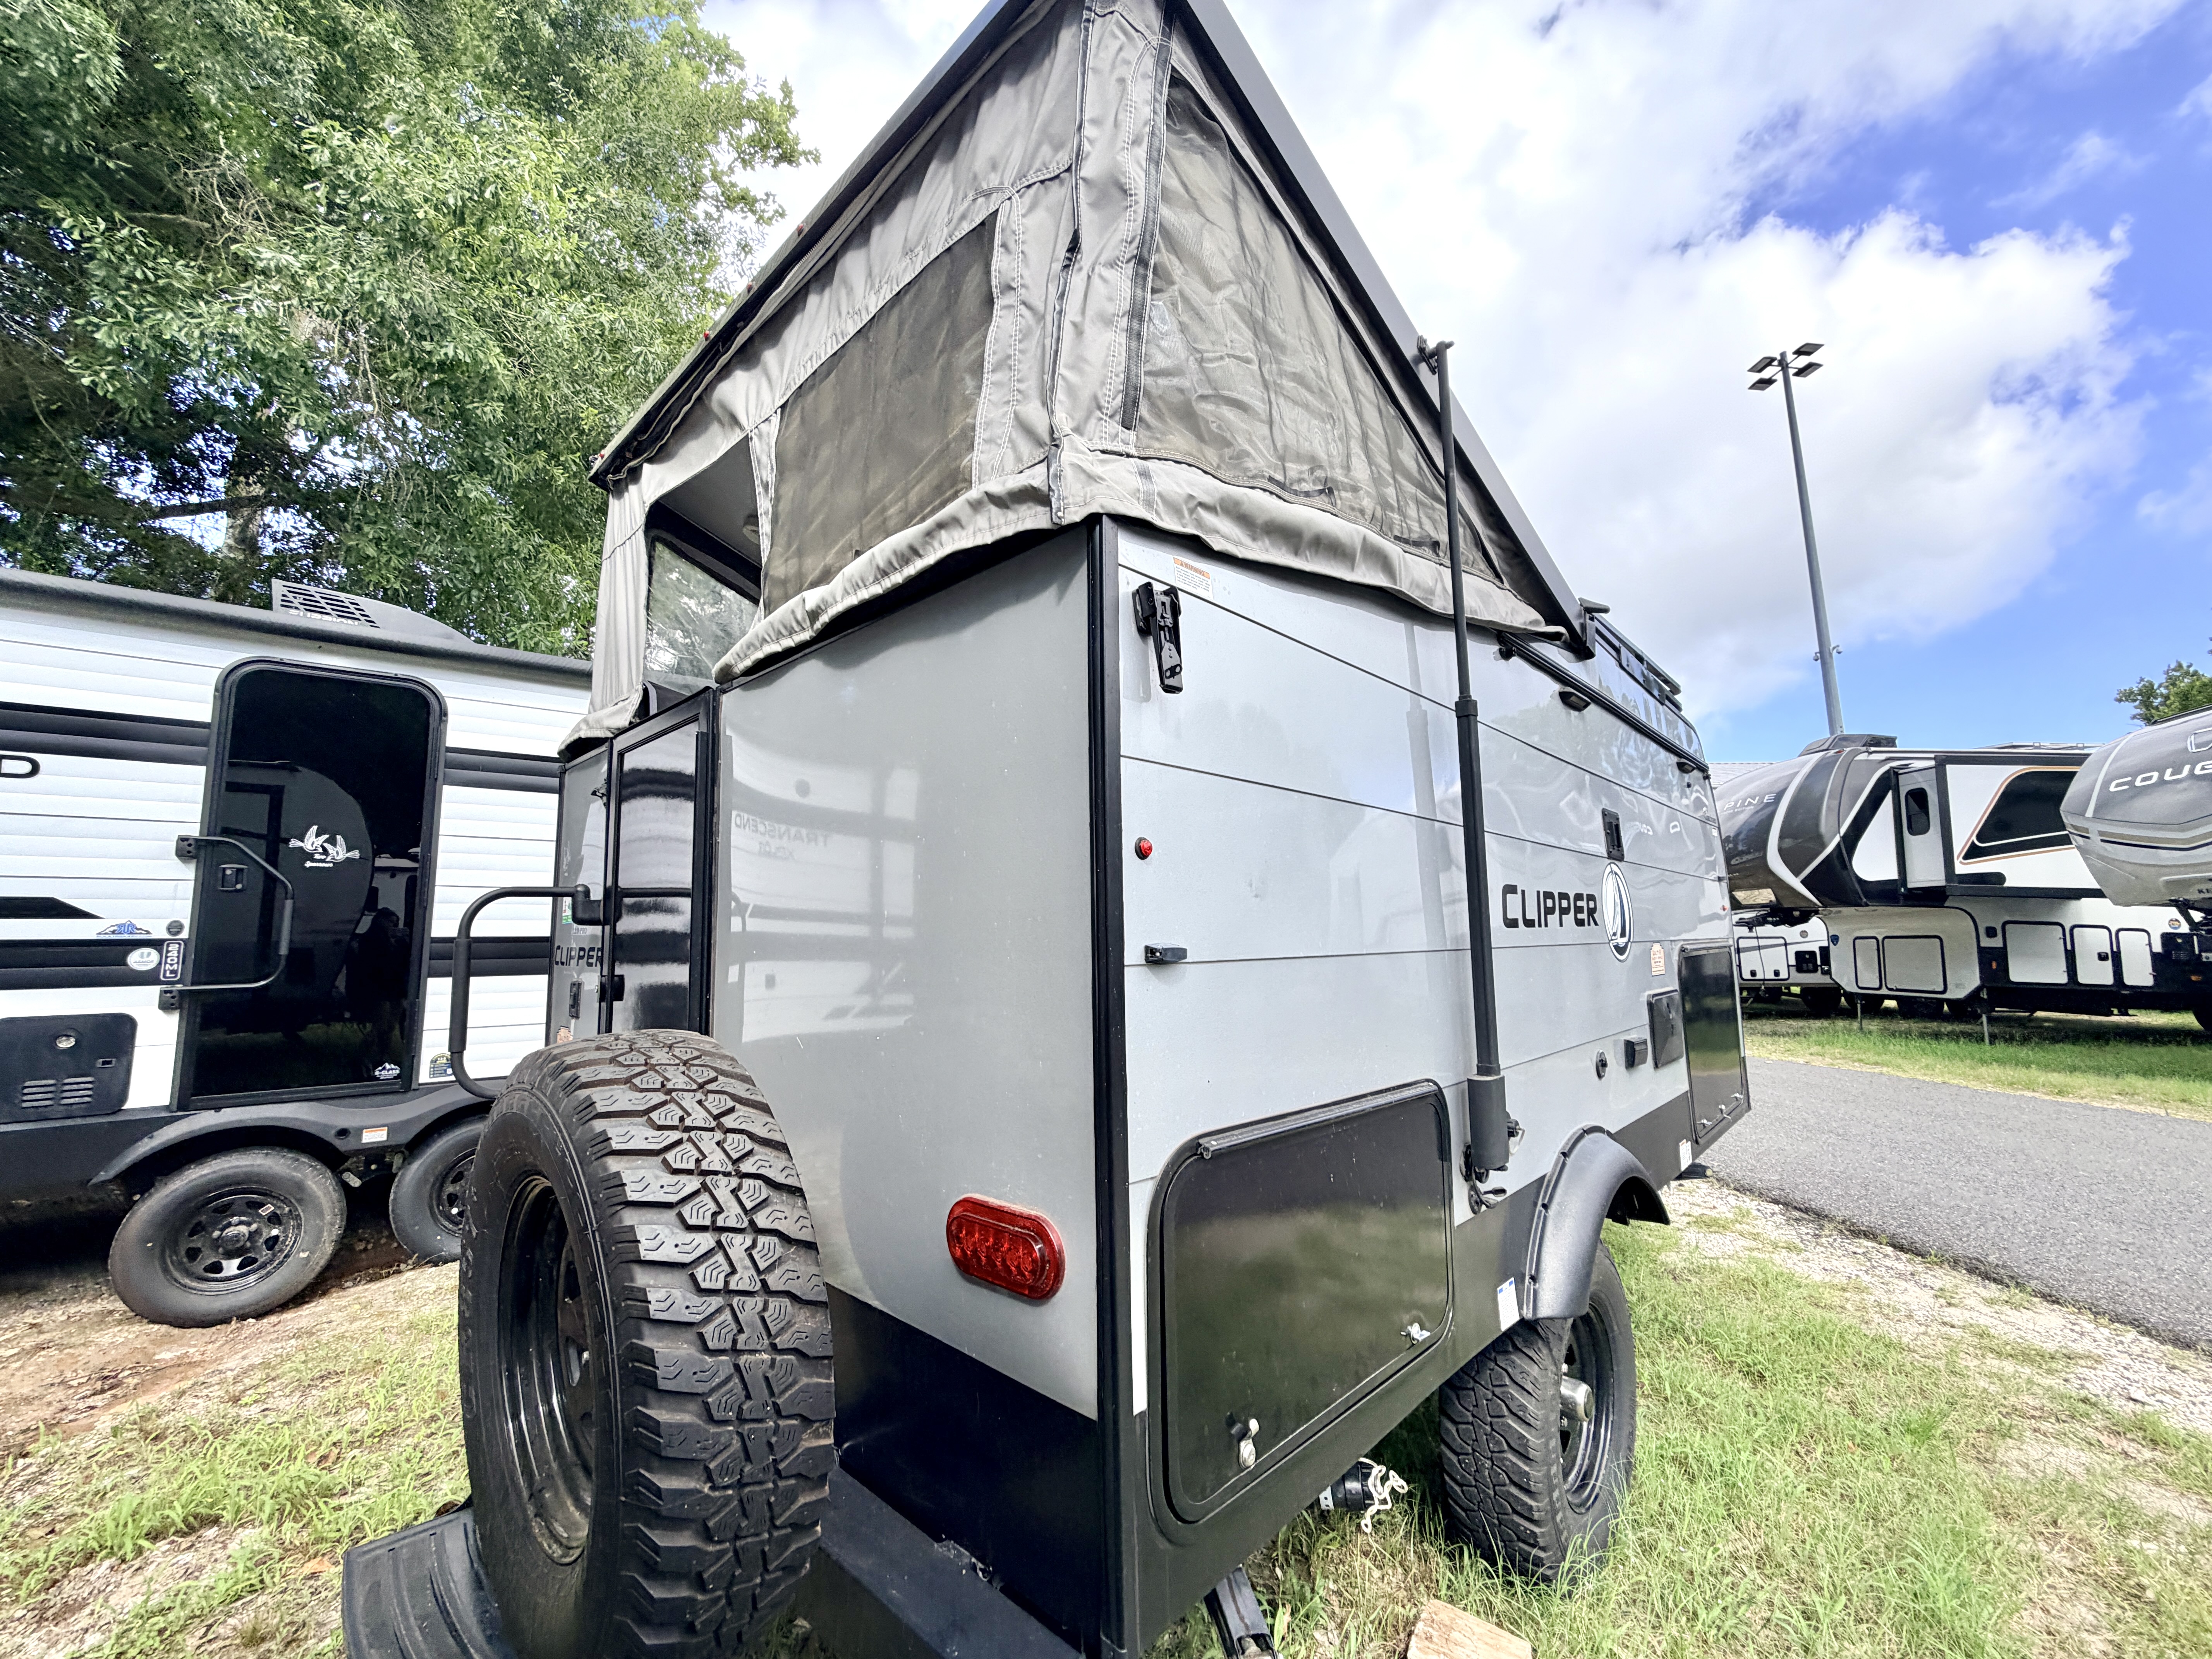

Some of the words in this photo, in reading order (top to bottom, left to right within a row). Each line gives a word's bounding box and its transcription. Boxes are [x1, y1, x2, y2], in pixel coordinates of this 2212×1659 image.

[1723, 793, 1777, 811] PINE
[1502, 884, 1599, 928] CLIPPER
[165, 944, 180, 977] 240ML
